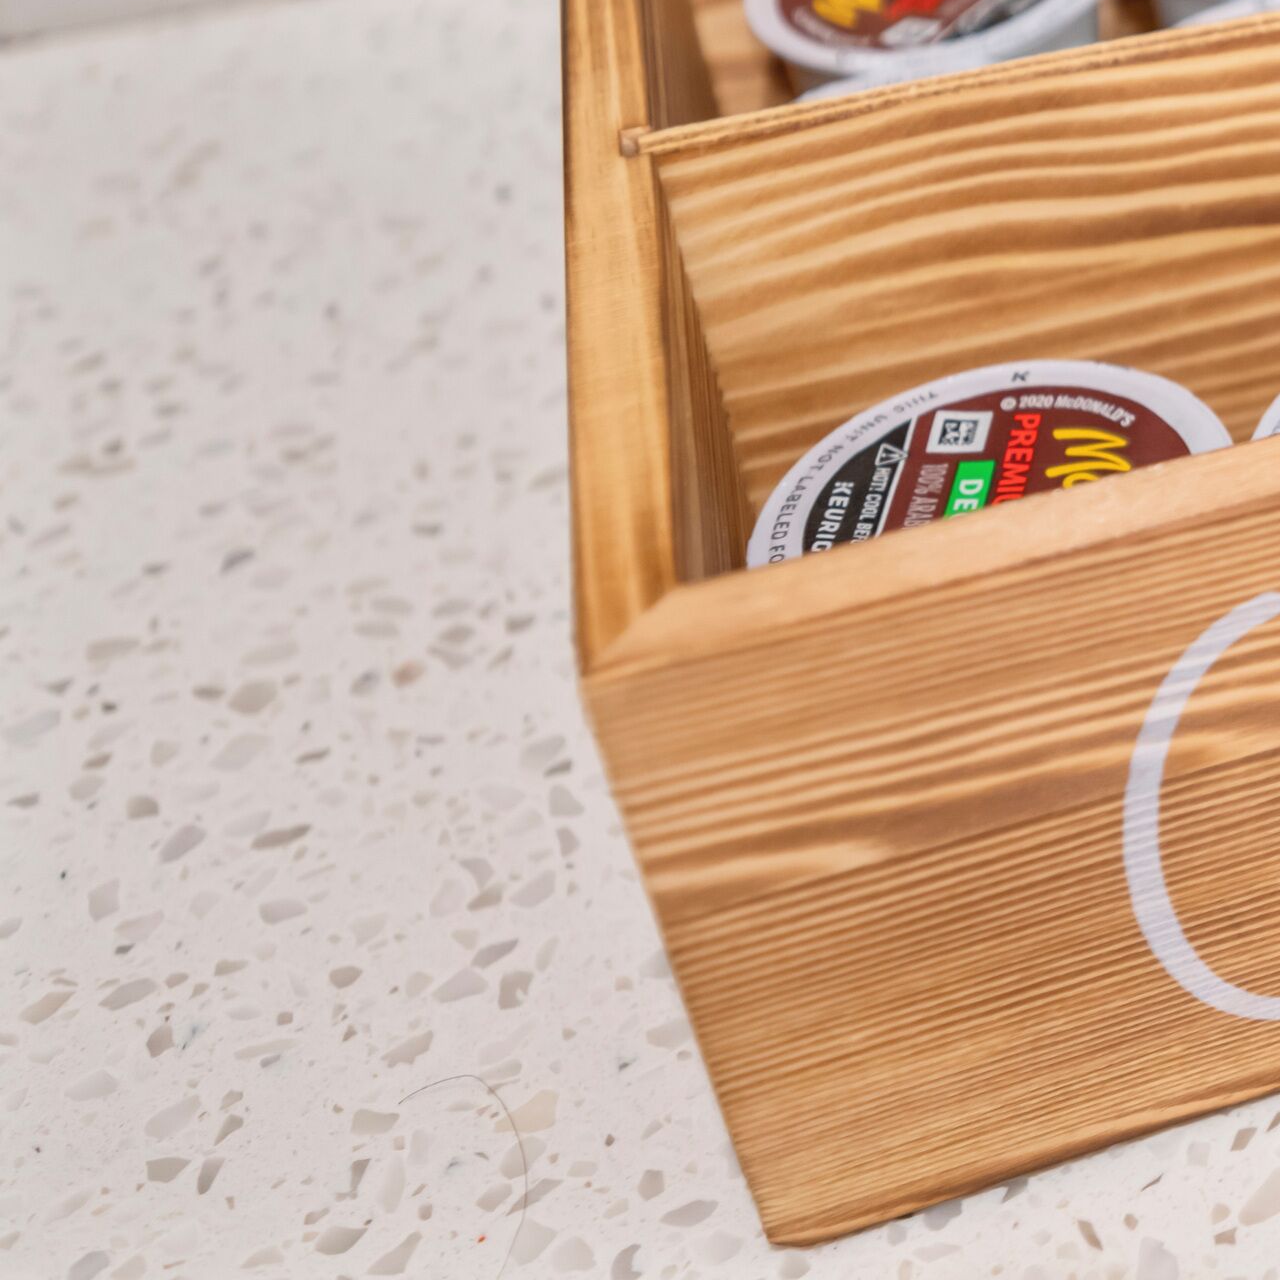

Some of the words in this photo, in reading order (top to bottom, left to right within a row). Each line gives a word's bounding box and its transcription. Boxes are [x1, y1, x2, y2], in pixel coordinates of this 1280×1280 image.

[1018, 393, 1054, 410] 2020
[810, 444, 845, 471] NOT
[991, 412, 1042, 507] PREMI
[868, 467, 892, 492] HOT!
[914, 463, 949, 494] 100%
[771, 476, 814, 540] LABELED
[859, 493, 883, 521] COOL
[768, 544, 786, 565] FO
